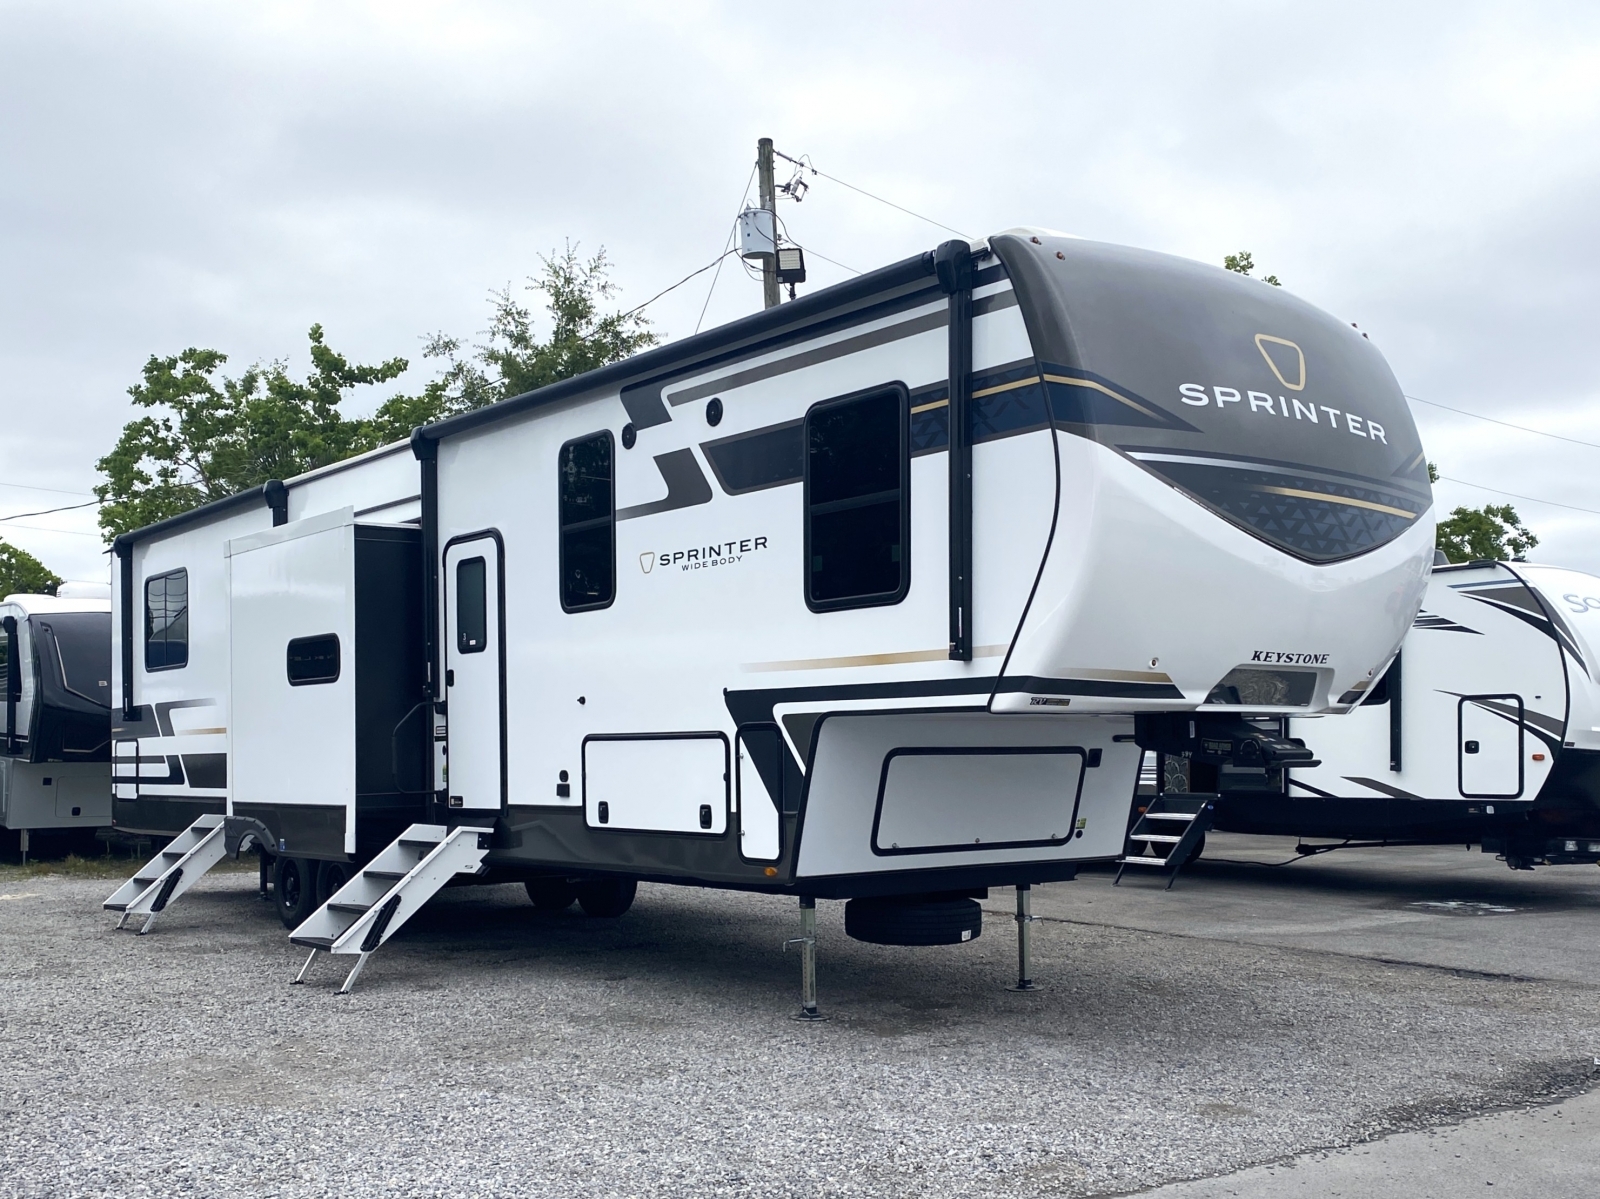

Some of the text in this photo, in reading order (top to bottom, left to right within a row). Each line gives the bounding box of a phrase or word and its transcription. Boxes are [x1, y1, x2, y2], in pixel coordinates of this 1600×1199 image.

[1179, 383, 1387, 445] SPRINTER
[659, 536, 768, 567] SPRINTER
[681, 554, 743, 571] WIDE BODY
[1250, 650, 1330, 665] KEYSTONE
